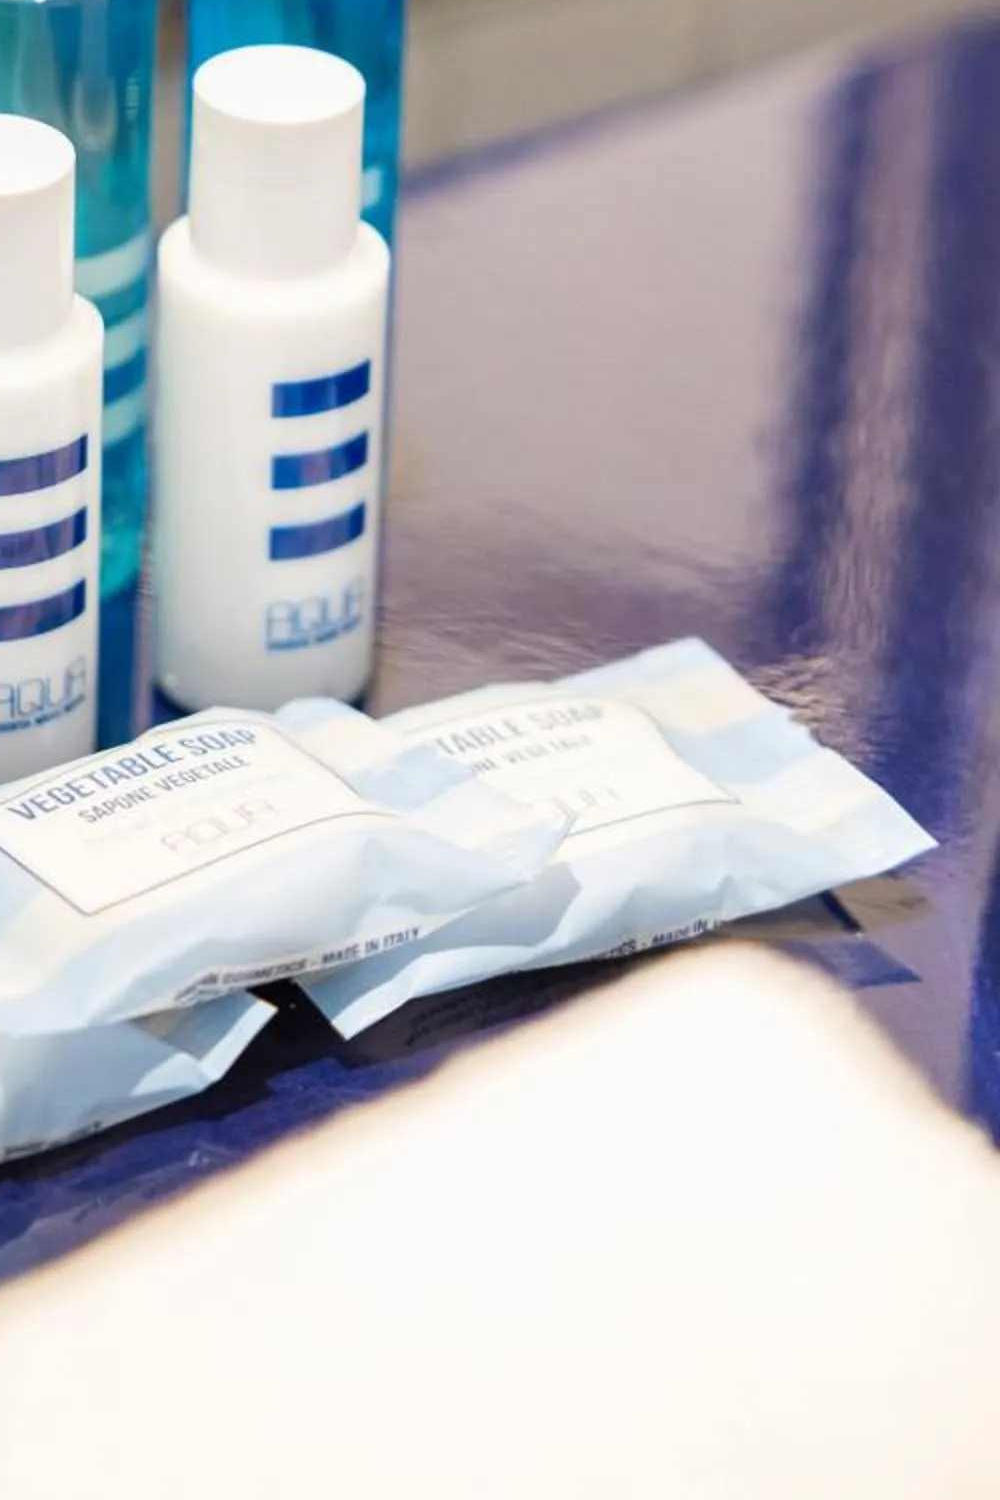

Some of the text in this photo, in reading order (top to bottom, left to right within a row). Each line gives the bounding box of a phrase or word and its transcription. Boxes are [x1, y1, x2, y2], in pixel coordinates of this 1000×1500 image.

[436, 718, 526, 757] TABLE
[6, 728, 257, 821] VEGETABLE SOAP
[77, 754, 252, 823] SAPONE VEGETALE
[364, 938, 380, 954] IN
[382, 926, 421, 949] ITALY
